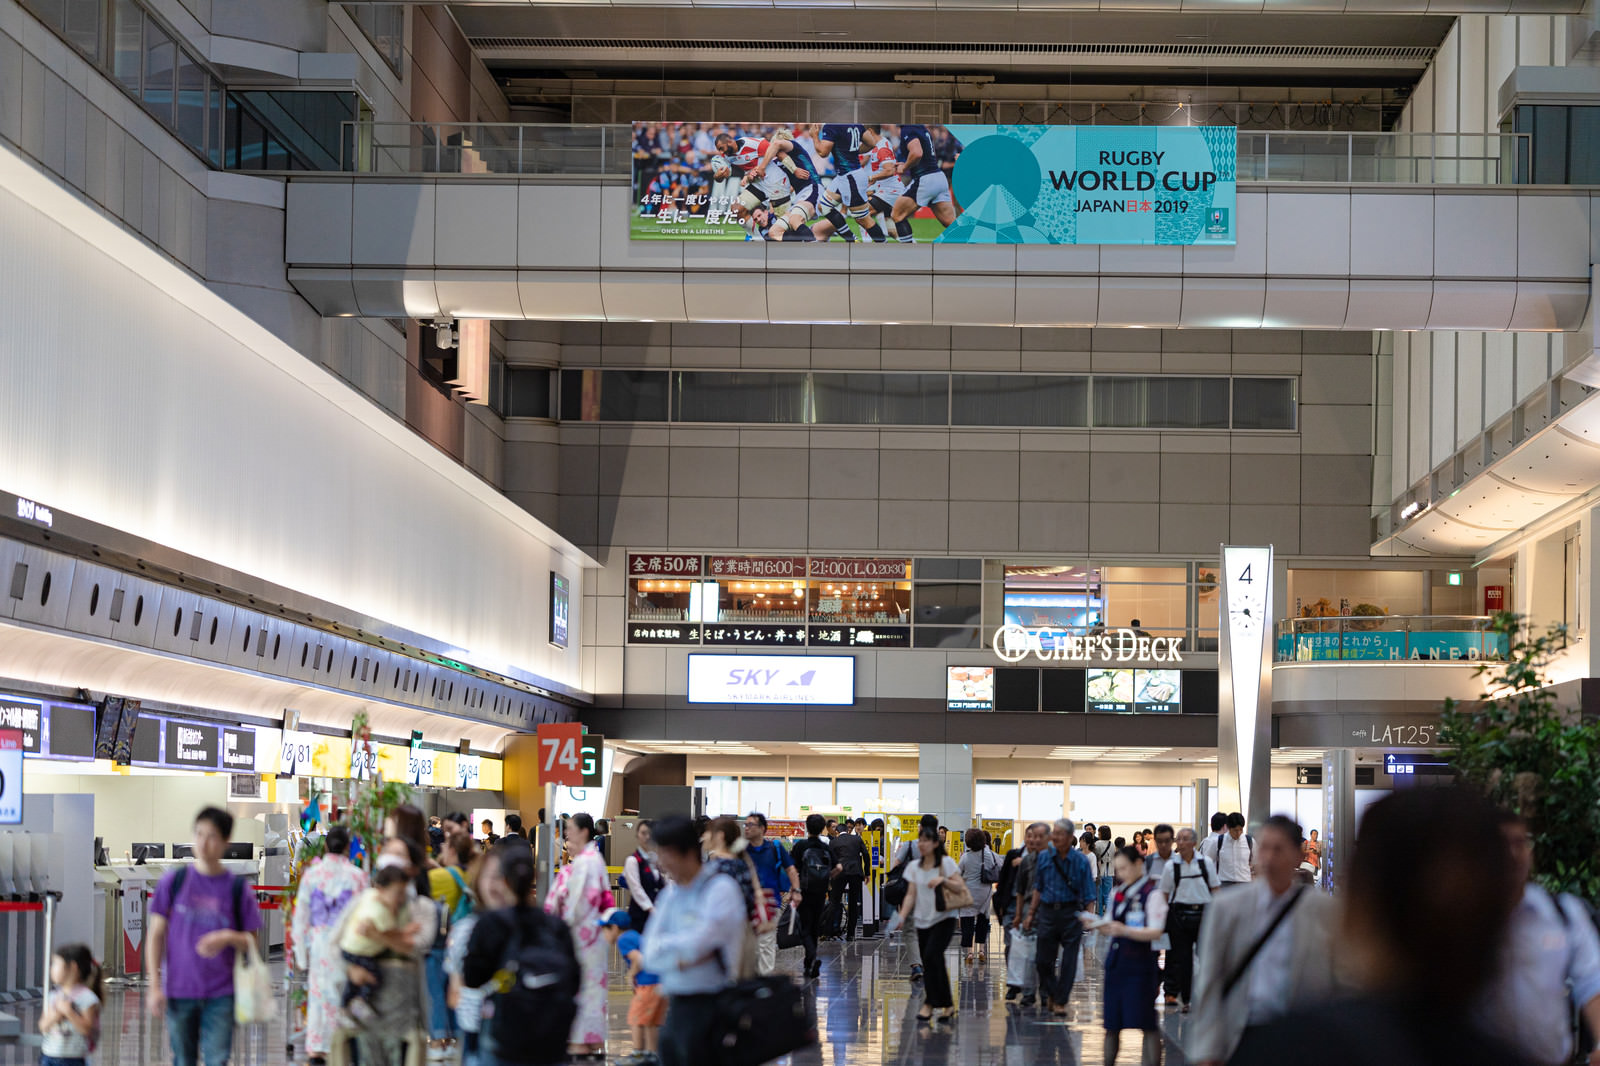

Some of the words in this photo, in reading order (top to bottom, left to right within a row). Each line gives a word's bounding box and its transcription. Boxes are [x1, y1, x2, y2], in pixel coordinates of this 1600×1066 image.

[847, 127, 860, 152] 20
[1099, 150, 1166, 166] RUGBY
[1048, 170, 1154, 192] WORLD
[640, 208, 746, 225] 一生に一度だ。
[632, 556, 699, 572] 全席50席
[1238, 562, 1253, 584] 4
[1116, 628, 1184, 662] DECK
[726, 668, 780, 686] SKY
[298, 744, 310, 762] 81
[542, 738, 578, 772] 74
[420, 759, 432, 775] 83
[468, 765, 478, 779] 84
